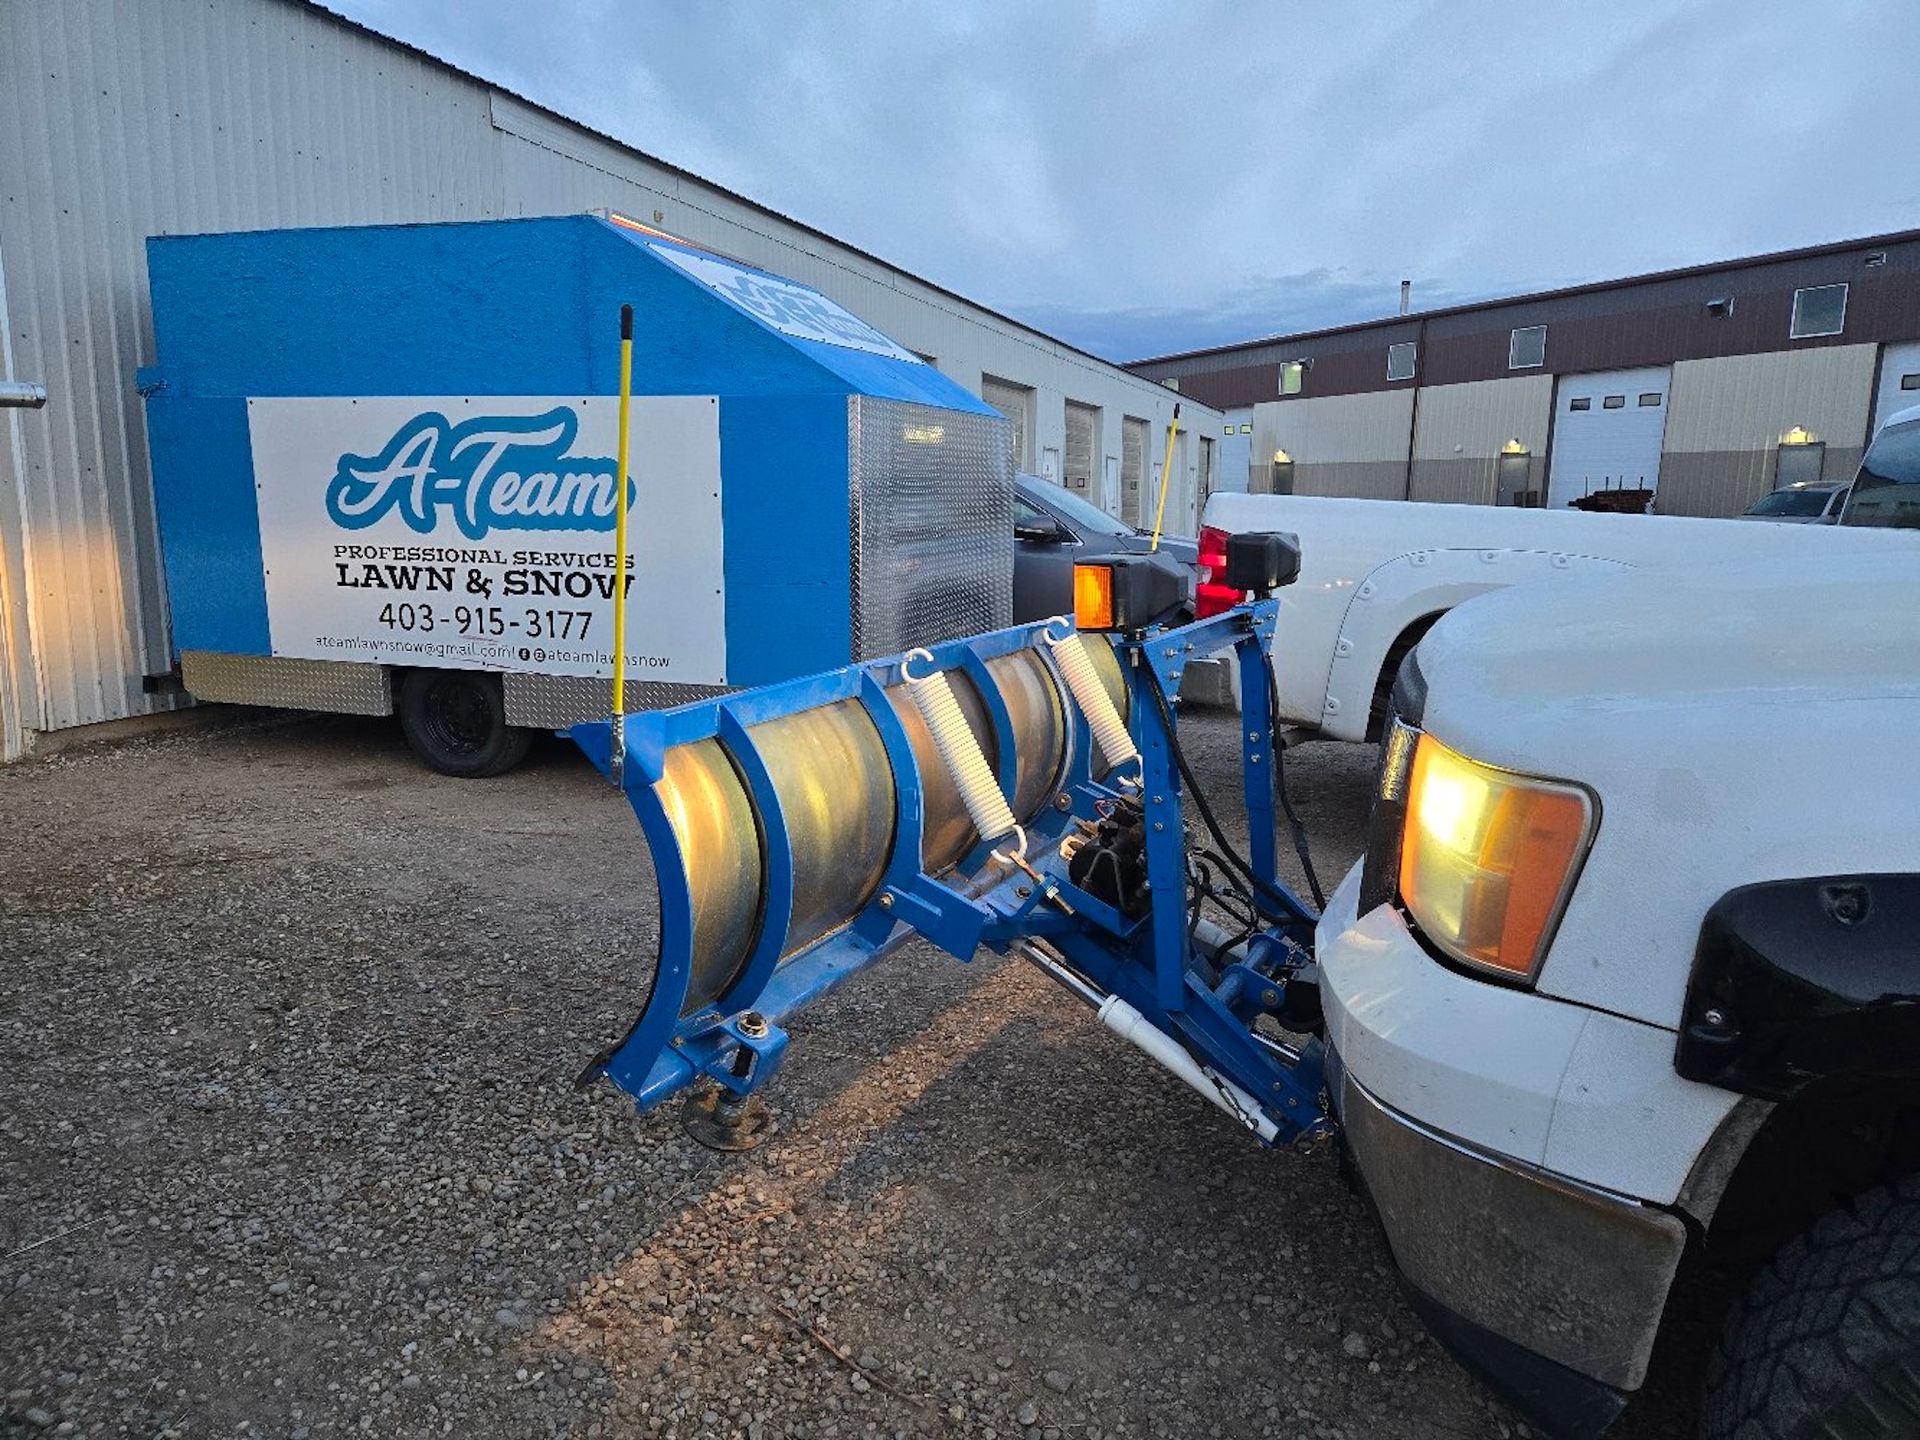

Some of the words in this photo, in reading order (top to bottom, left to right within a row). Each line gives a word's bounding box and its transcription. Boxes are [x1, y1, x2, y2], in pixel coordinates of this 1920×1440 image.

[337, 420, 619, 522] A-Team
[334, 545, 507, 564] PROFESSIONAL
[513, 551, 635, 570] SERVICES
[335, 563, 456, 592] LAWN
[466, 568, 493, 600] &
[503, 568, 636, 600] SNOW
[379, 603, 593, 640] 403-915-3177
